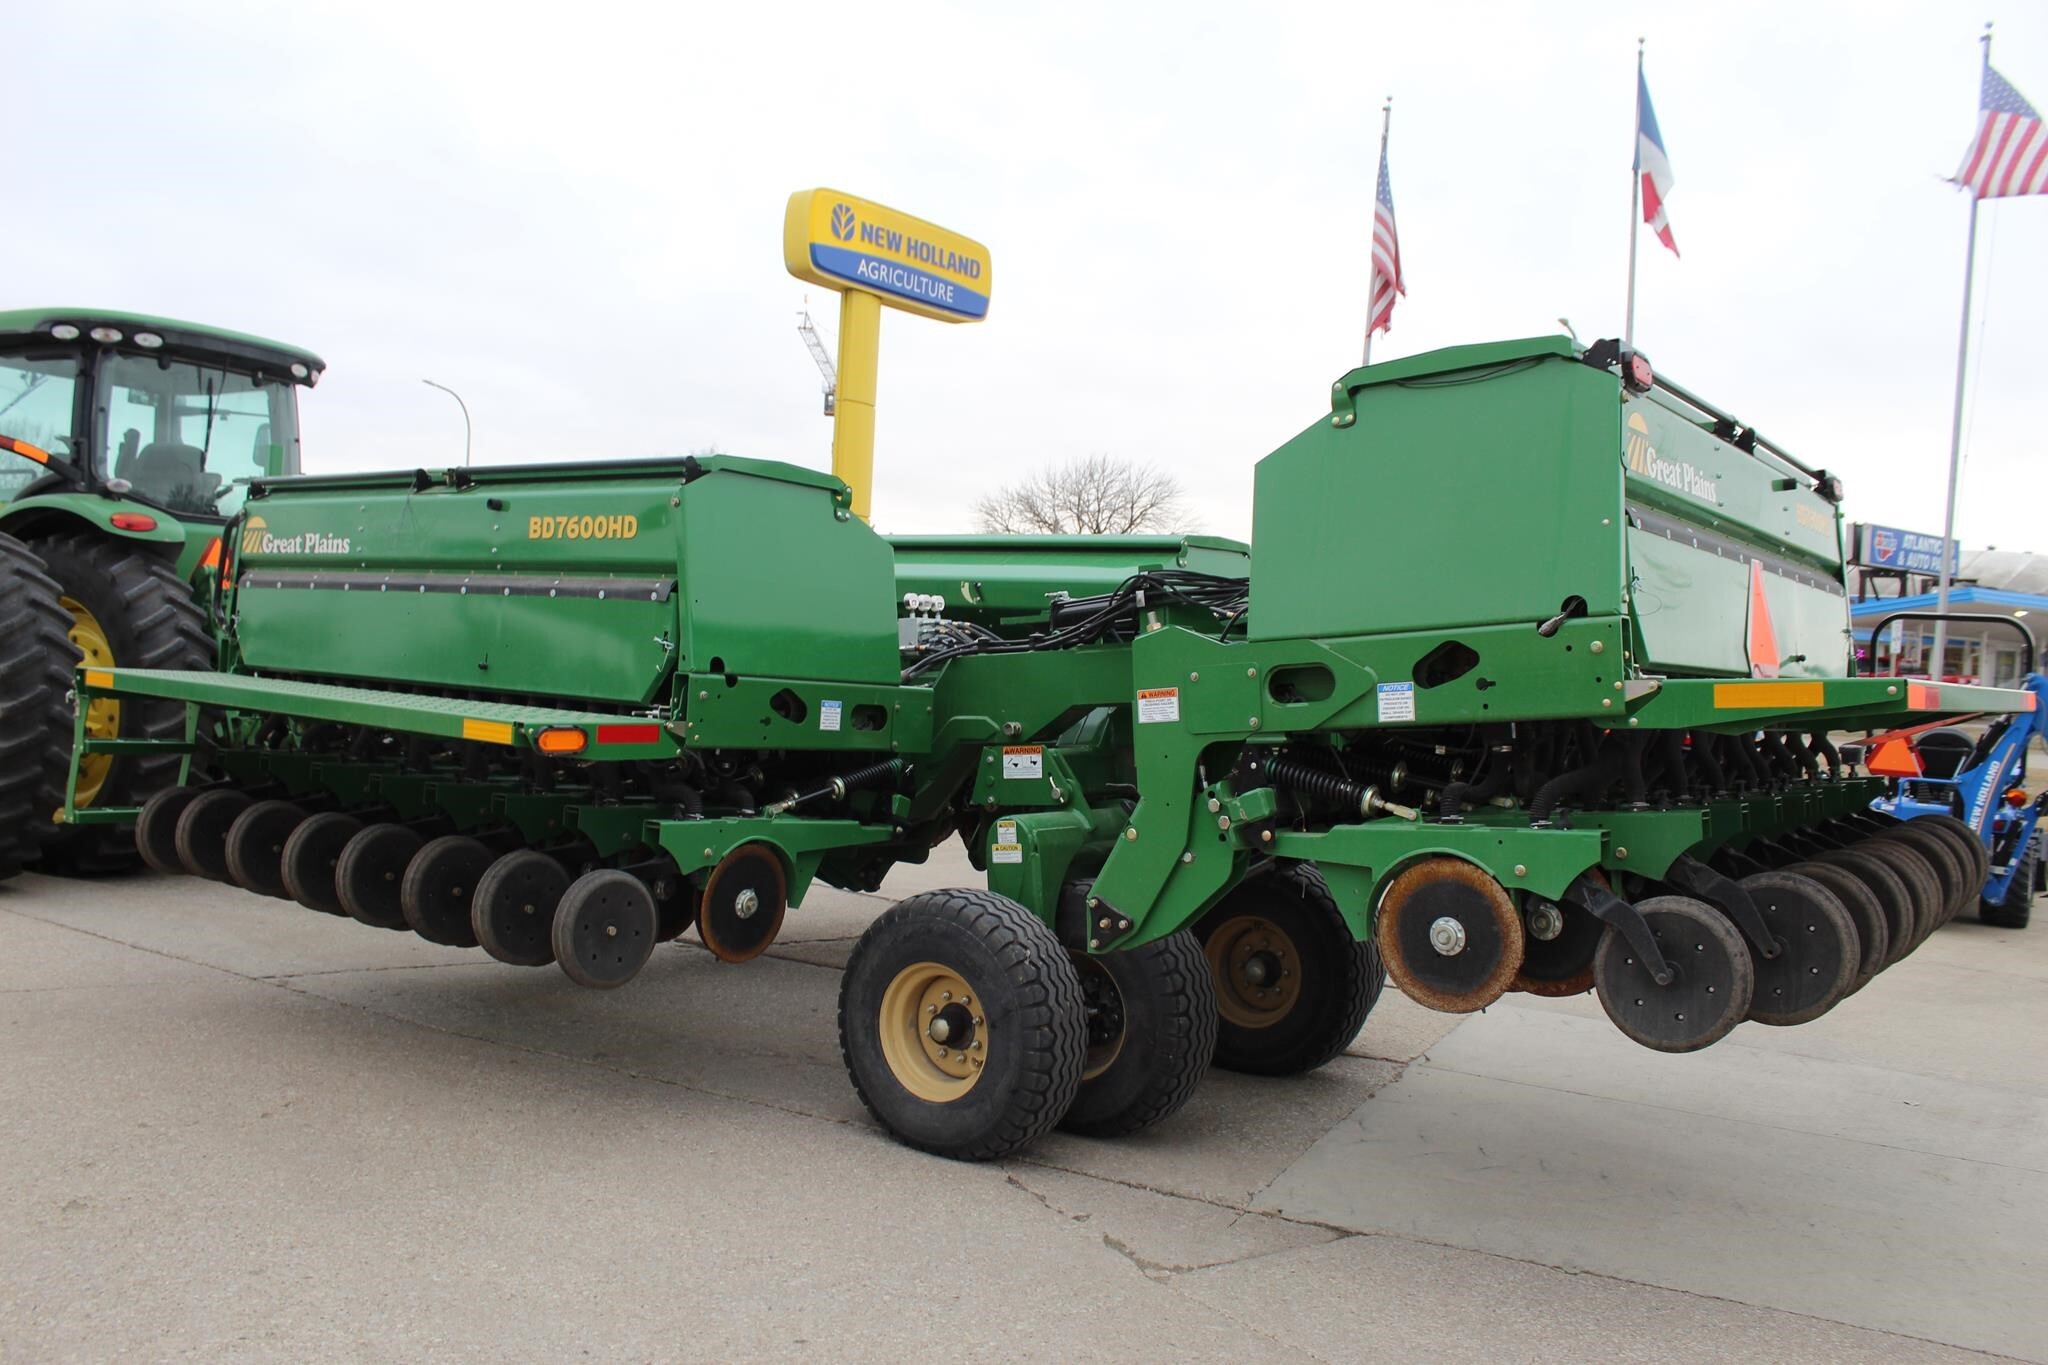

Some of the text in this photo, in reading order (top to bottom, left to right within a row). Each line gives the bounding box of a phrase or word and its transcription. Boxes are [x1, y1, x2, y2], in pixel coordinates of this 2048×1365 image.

[861, 221, 981, 280] NEW HOLLAND
[857, 258, 954, 303] AGRICULTURE
[1646, 446, 1716, 503] Great Plains
[528, 514, 639, 540] BD7600HD
[262, 532, 351, 554] Great Plains
[1901, 533, 1944, 556] ATLANTIC
[1897, 550, 1906, 566] &
[1906, 551, 1931, 571] AUTO
[1149, 688, 1176, 698] WARNING
[1382, 683, 1411, 692] NOTICE
[1010, 746, 1041, 754] WARNING
[1968, 761, 2000, 830] NEW HOLLAND
